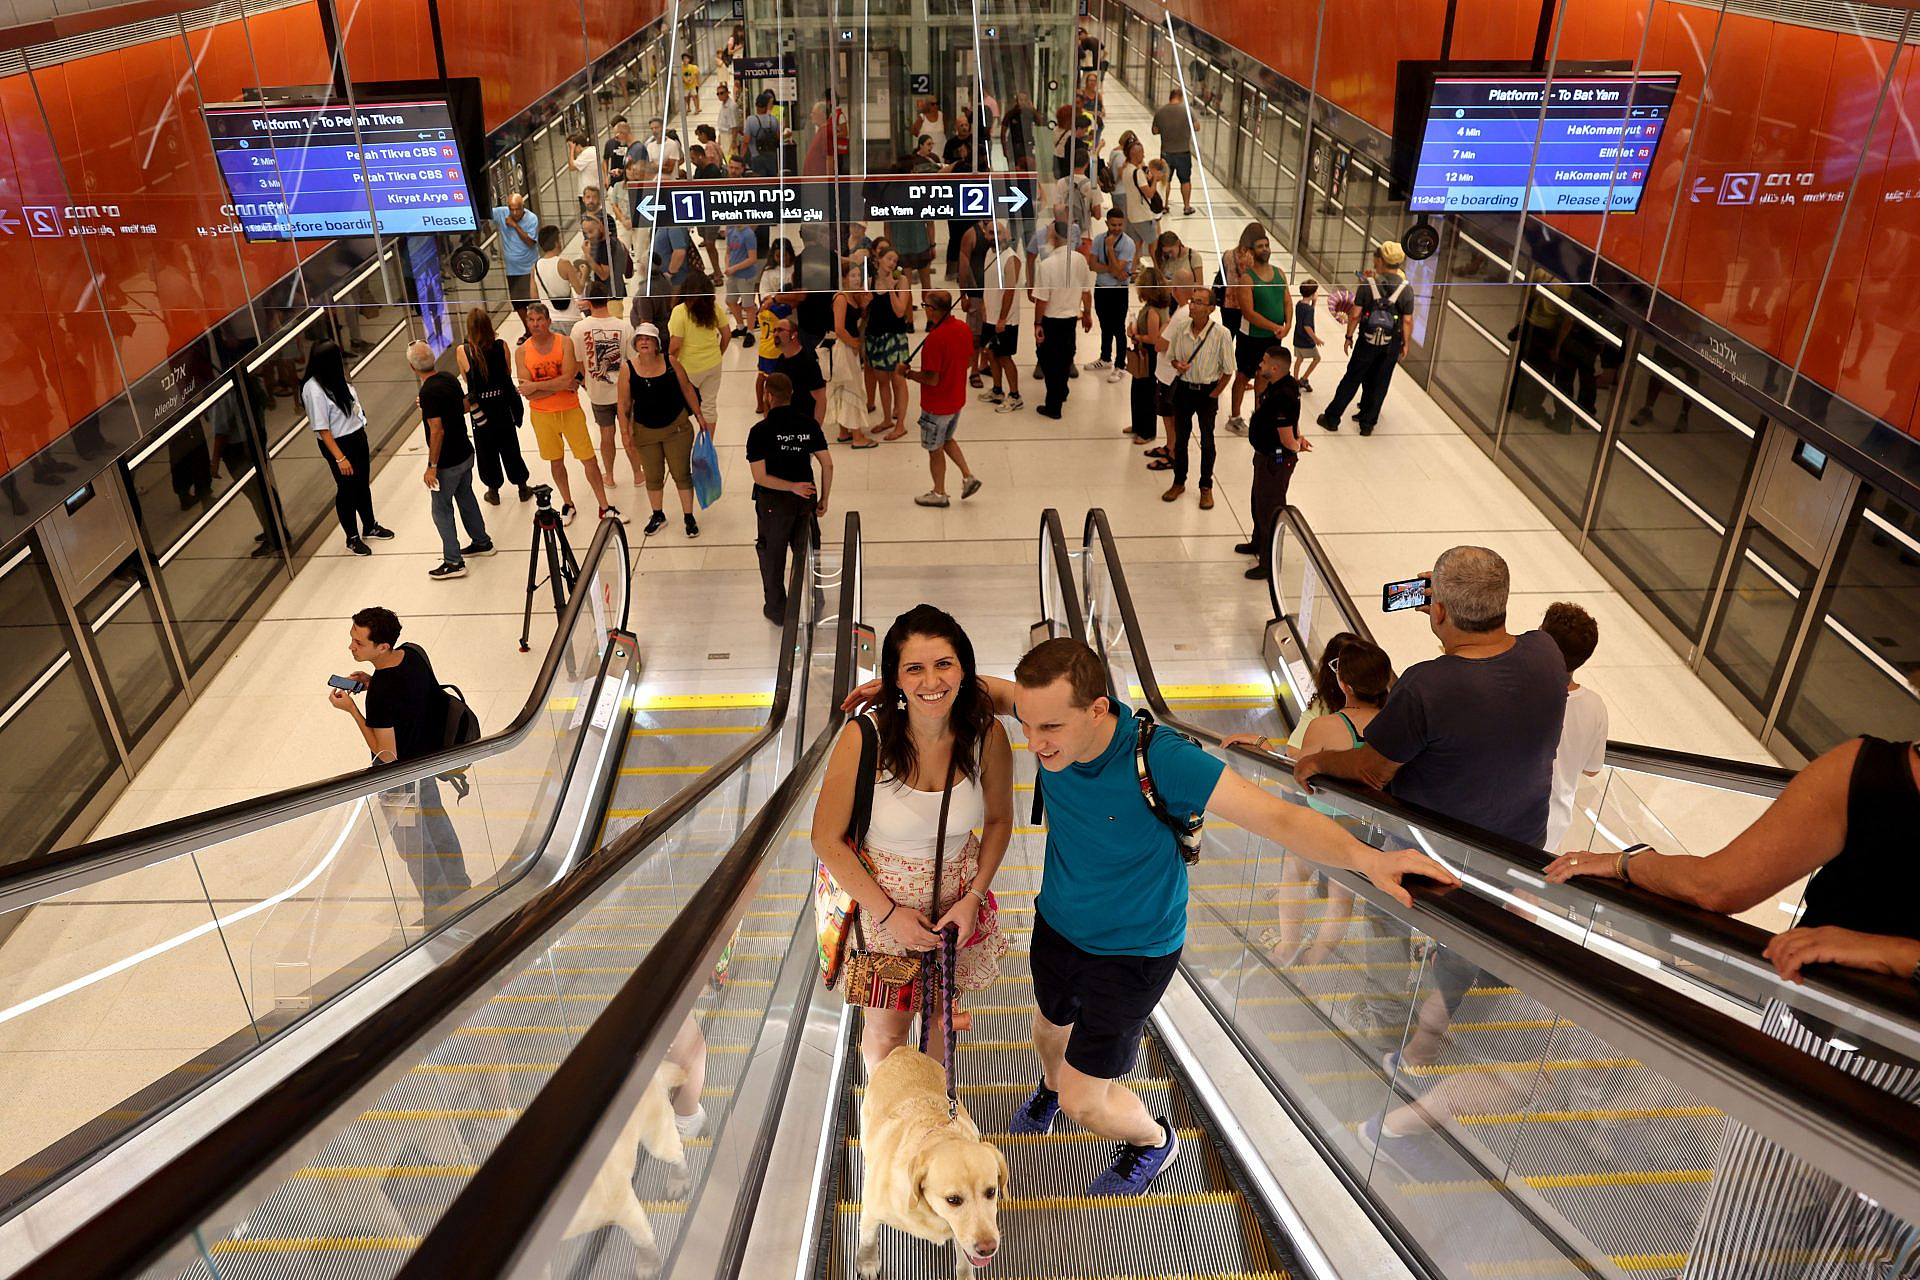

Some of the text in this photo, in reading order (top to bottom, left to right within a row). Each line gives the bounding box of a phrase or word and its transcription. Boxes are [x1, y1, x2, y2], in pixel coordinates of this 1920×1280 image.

[912, 77, 928, 94] -2
[1489, 89, 1538, 101] Platform
[1558, 89, 1571, 101] To
[1573, 89, 1593, 101] Bat
[1595, 89, 1620, 101] Yam
[302, 117, 310, 129] 1
[319, 116, 334, 128] To
[370, 114, 404, 126] Tikva
[1456, 126, 1481, 137] 4 Min
[1567, 124, 1656, 136] HaKomemyut R1
[346, 147, 454, 160] Peah Tikva CBS R1
[1453, 149, 1476, 160] 7 Min
[1638, 149, 1649, 157] R3
[251, 156, 276, 166] 2 Min
[386, 171, 417, 181] Tikva
[418, 169, 443, 179] CBS
[448, 170, 459, 179] R1
[1445, 172, 1474, 182] 12 Min
[1555, 170, 1627, 181] HaKomemiut
[259, 179, 267, 188] 3
[387, 192, 464, 204] Kiryat Arye R3
[710, 188, 796, 207] פתח תקווה
[909, 185, 954, 199] בת ים
[967, 188, 984, 211] 2
[1461, 194, 1519, 207] boarding
[1557, 194, 1634, 205] Please alow
[681, 195, 694, 218] 1
[870, 205, 914, 217] Bat Yam
[422, 213, 464, 227] Please
[711, 208, 774, 222] Petah Tikva
[1709, 335, 1738, 366] אלנבי
[161, 363, 187, 391] אלנבי
[154, 394, 178, 420] Allenby
